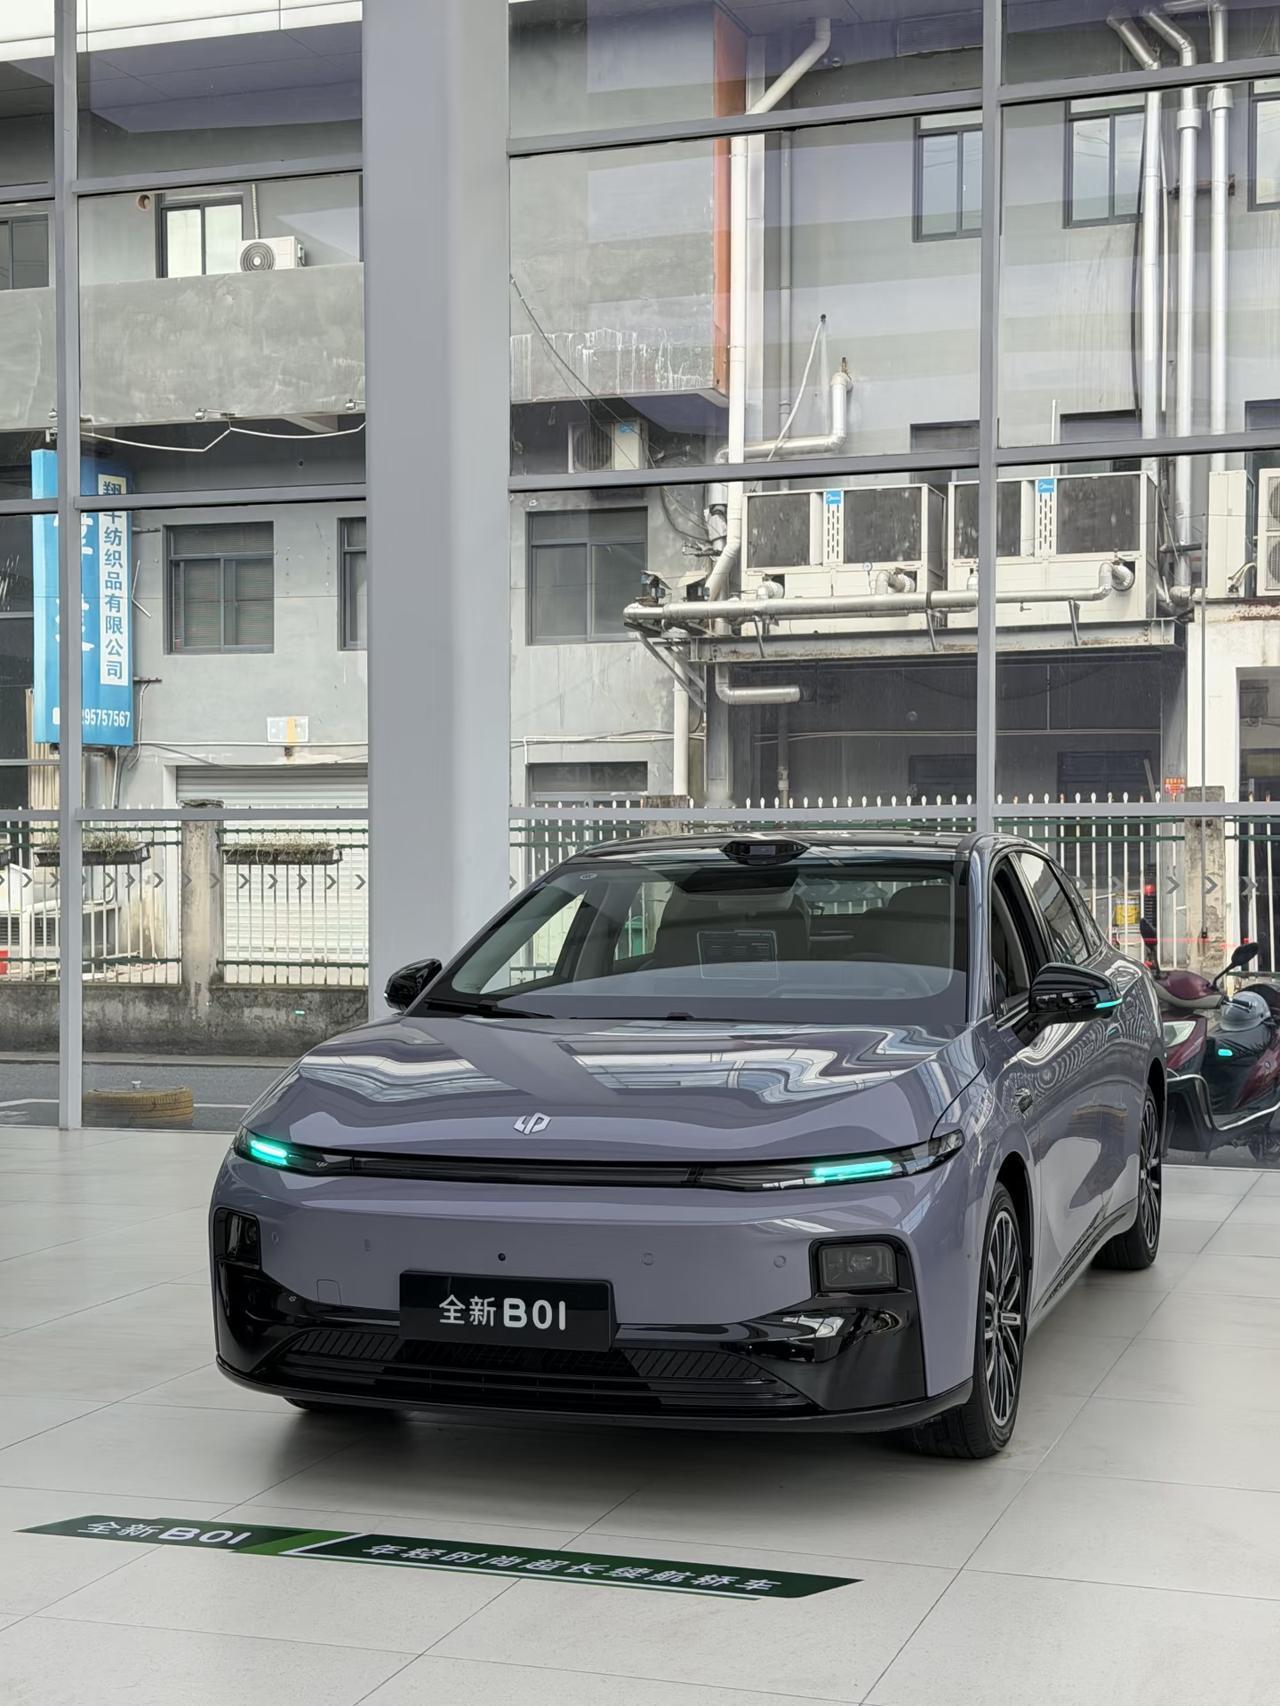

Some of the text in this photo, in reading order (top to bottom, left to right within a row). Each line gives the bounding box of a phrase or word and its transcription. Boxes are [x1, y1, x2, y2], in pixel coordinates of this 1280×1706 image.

[362, 1543, 782, 1591] 年轻时尚超长续航轿车
